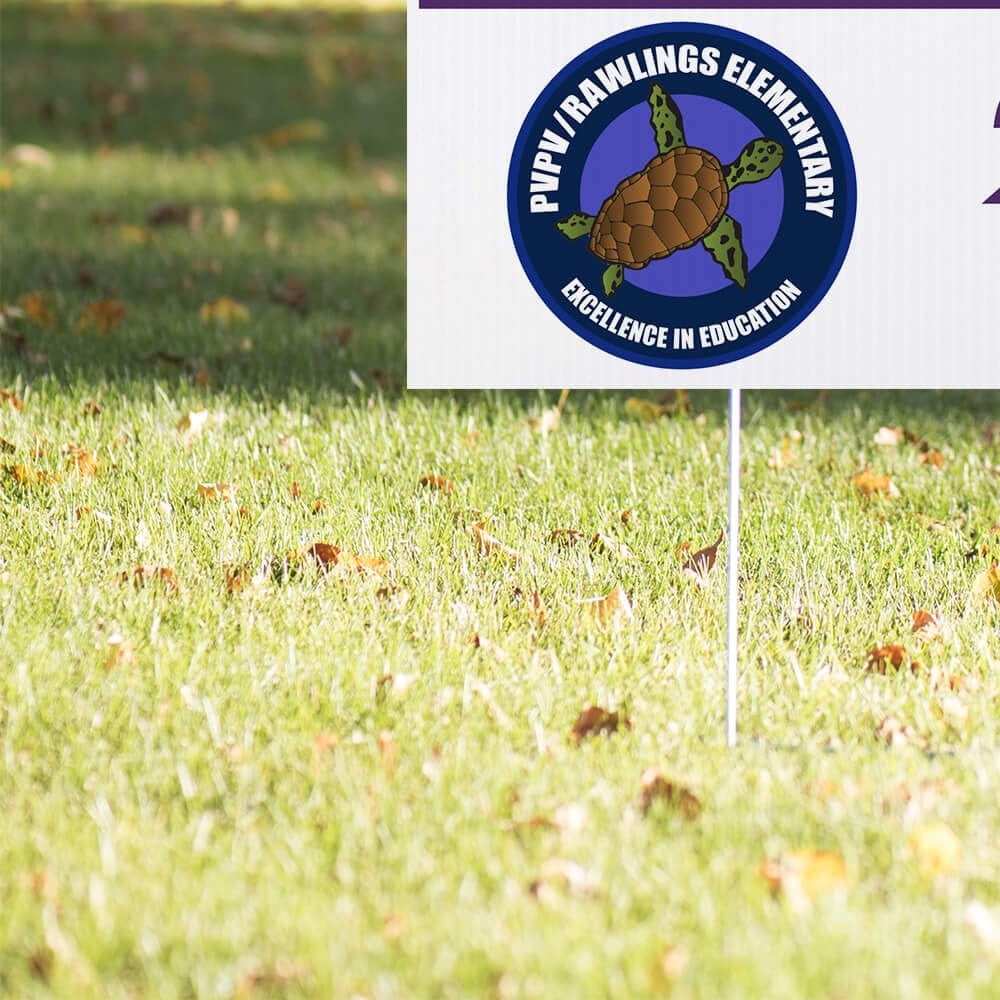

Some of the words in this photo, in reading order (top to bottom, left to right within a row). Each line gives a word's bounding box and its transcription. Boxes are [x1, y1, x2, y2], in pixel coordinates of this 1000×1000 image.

[530, 44, 721, 213] PVPV/RAWLINGS
[722, 53, 835, 218] ELEMENTARY
[560, 277, 667, 349] EXCELLENCE
[673, 328, 694, 350] IN
[700, 279, 802, 349] EDUCATION
